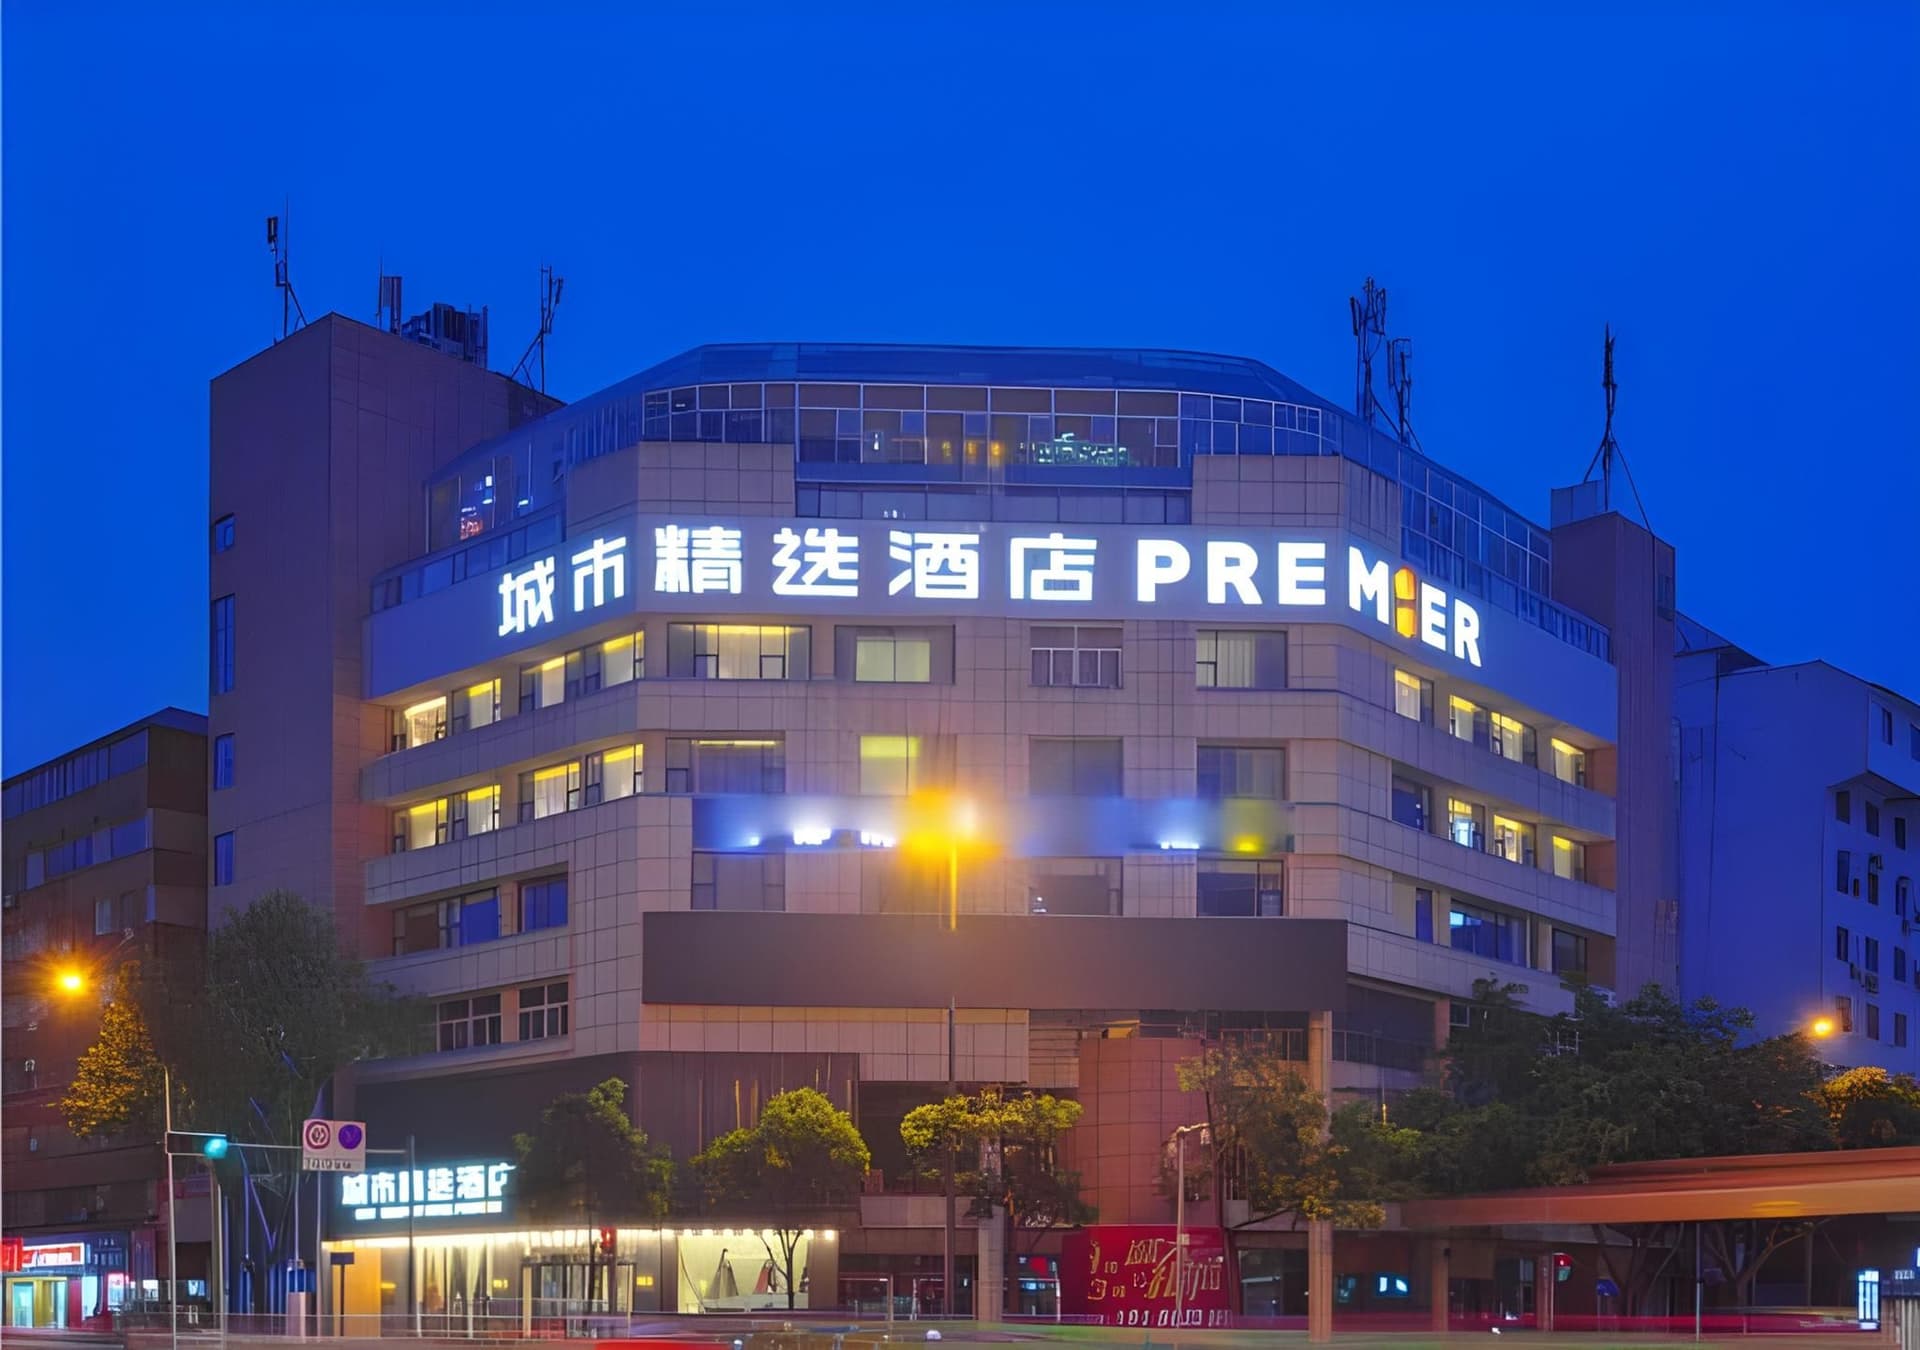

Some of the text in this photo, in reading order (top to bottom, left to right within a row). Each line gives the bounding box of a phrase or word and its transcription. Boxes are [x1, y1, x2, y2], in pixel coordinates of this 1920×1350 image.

[498, 524, 1482, 668] 城市精选酒店 PREMIER
